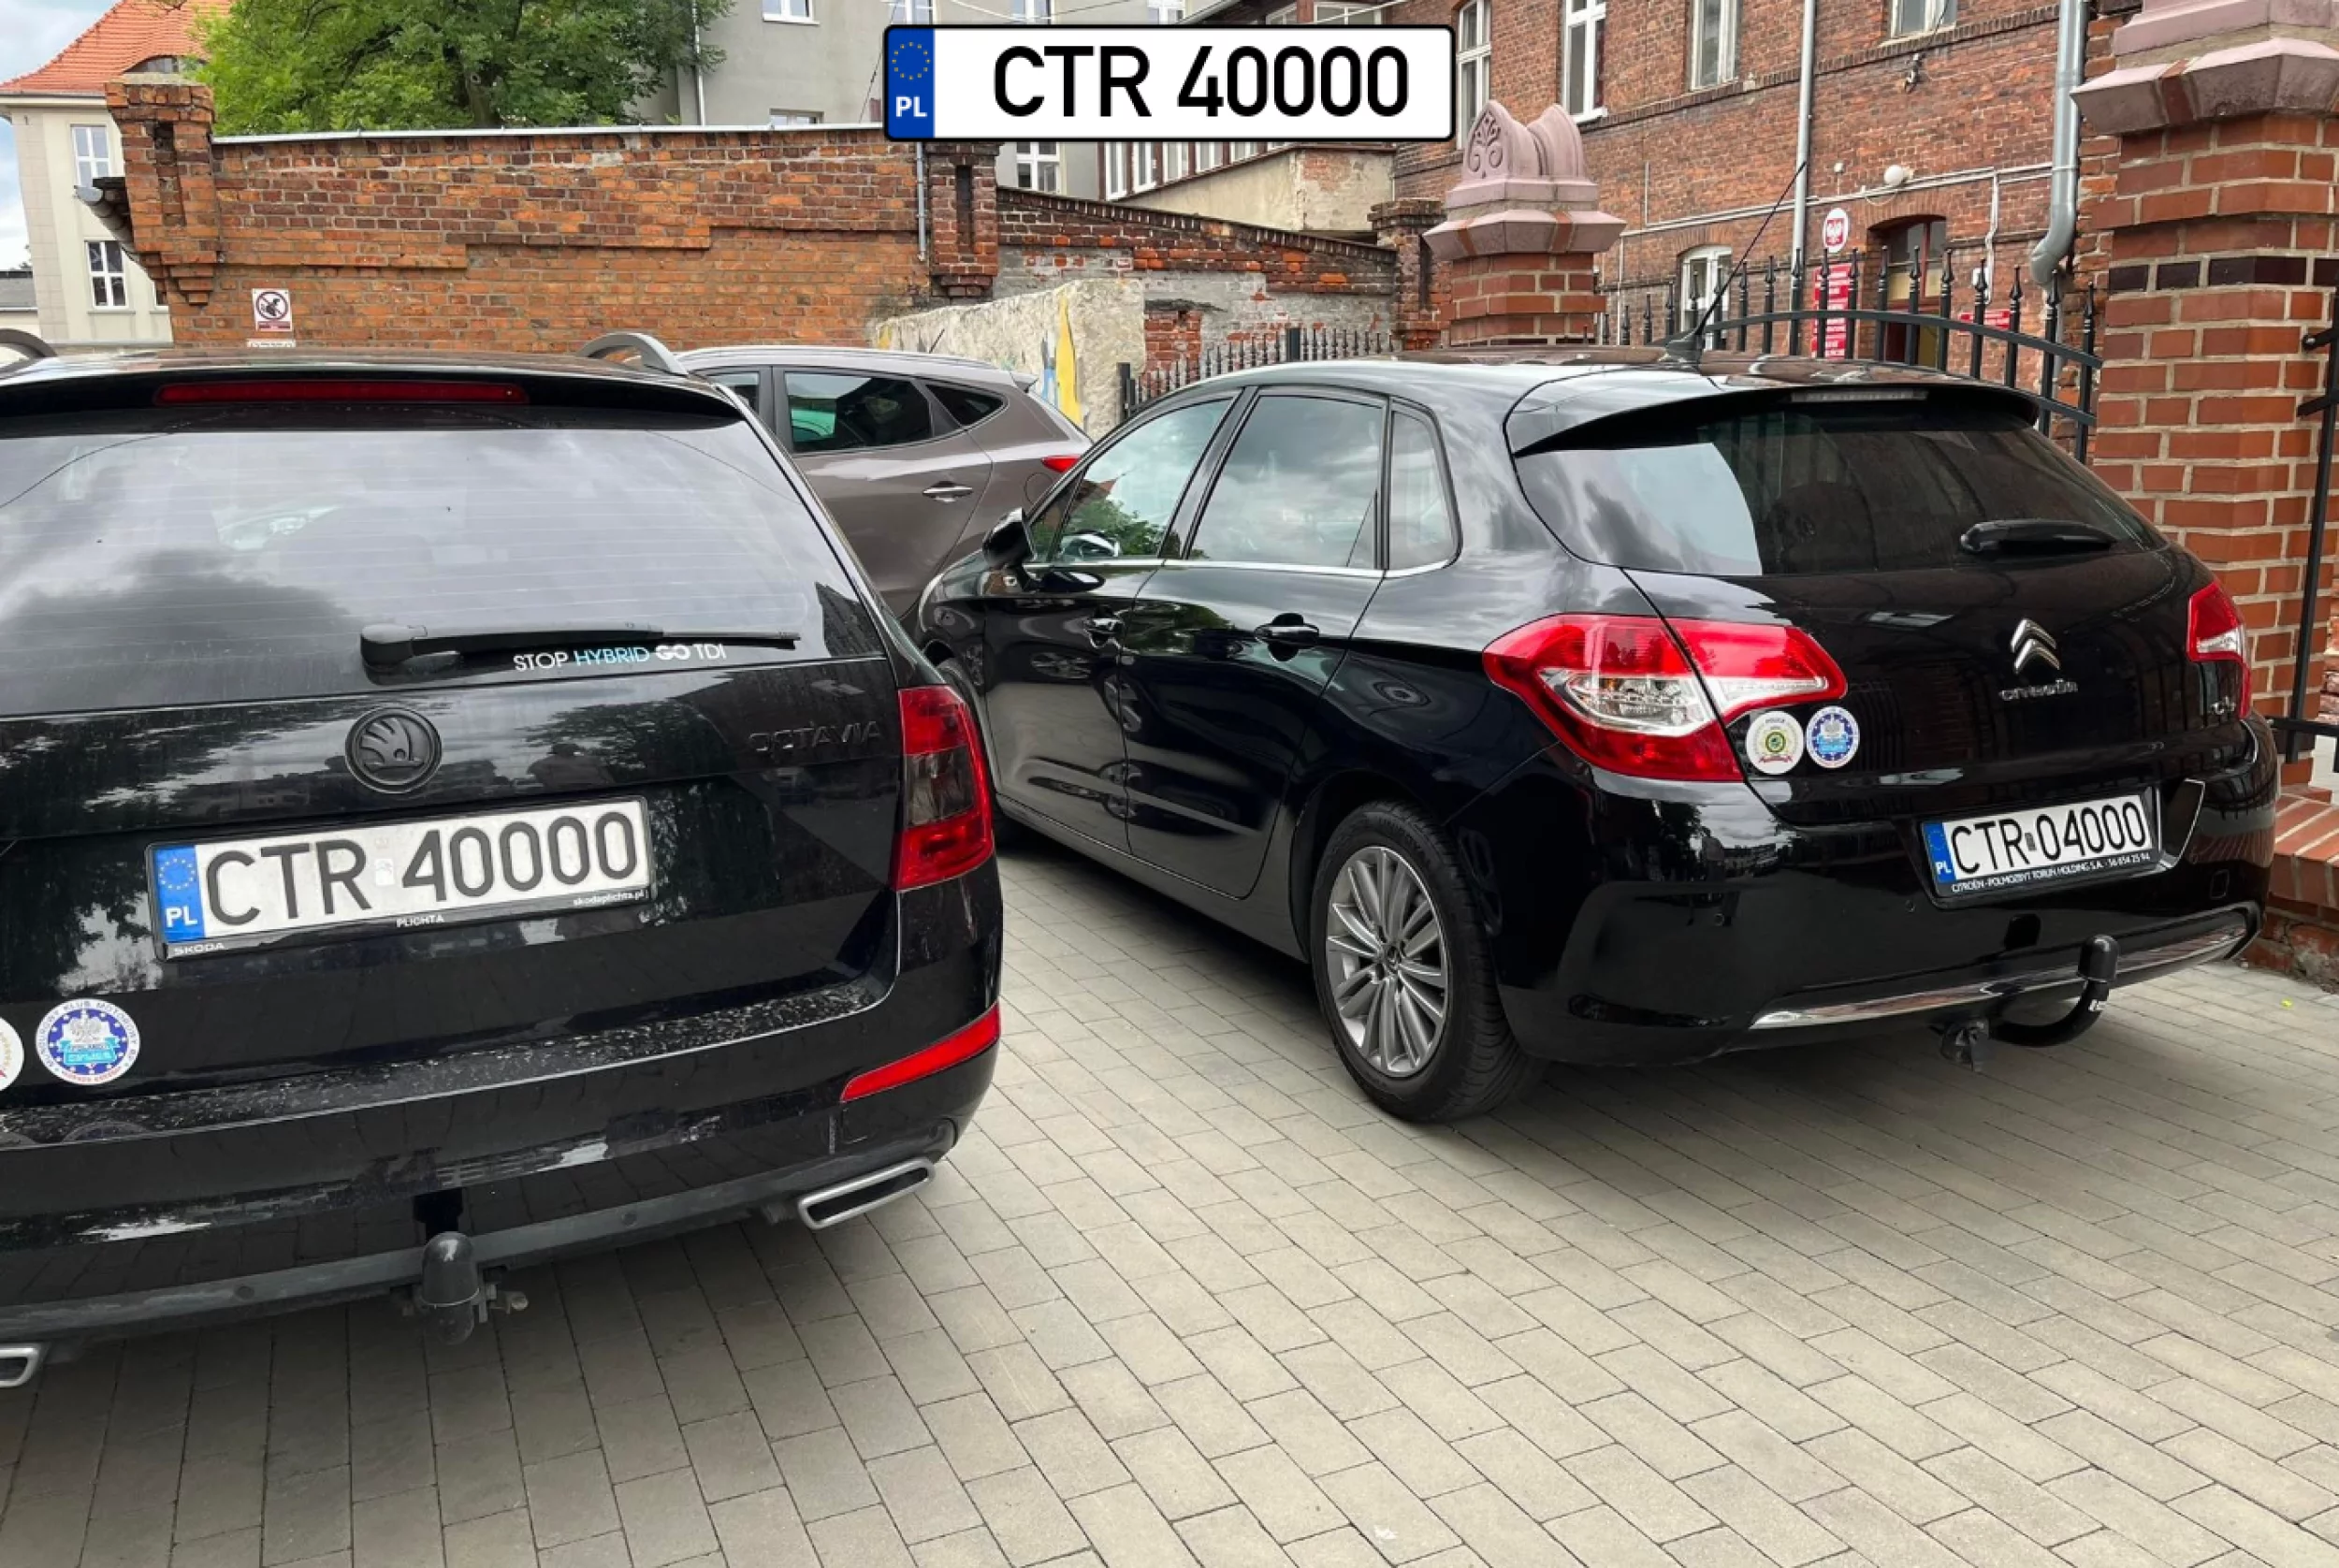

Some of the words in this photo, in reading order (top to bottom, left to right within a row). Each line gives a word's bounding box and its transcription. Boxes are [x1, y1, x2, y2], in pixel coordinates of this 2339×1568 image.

[513, 651, 569, 672] STOP
[574, 646, 650, 666] HYBRID
[655, 644, 691, 661] GO
[691, 643, 727, 661] TDI
[748, 720, 884, 751] OCTAVIA
[1950, 819, 2030, 875] CTR
[2035, 802, 2146, 861] 04000
[205, 839, 372, 926] CTR
[400, 811, 638, 903] 40000
[1935, 861, 1952, 875] PL
[165, 906, 198, 928] PL
[396, 913, 444, 929] PLICHTA
